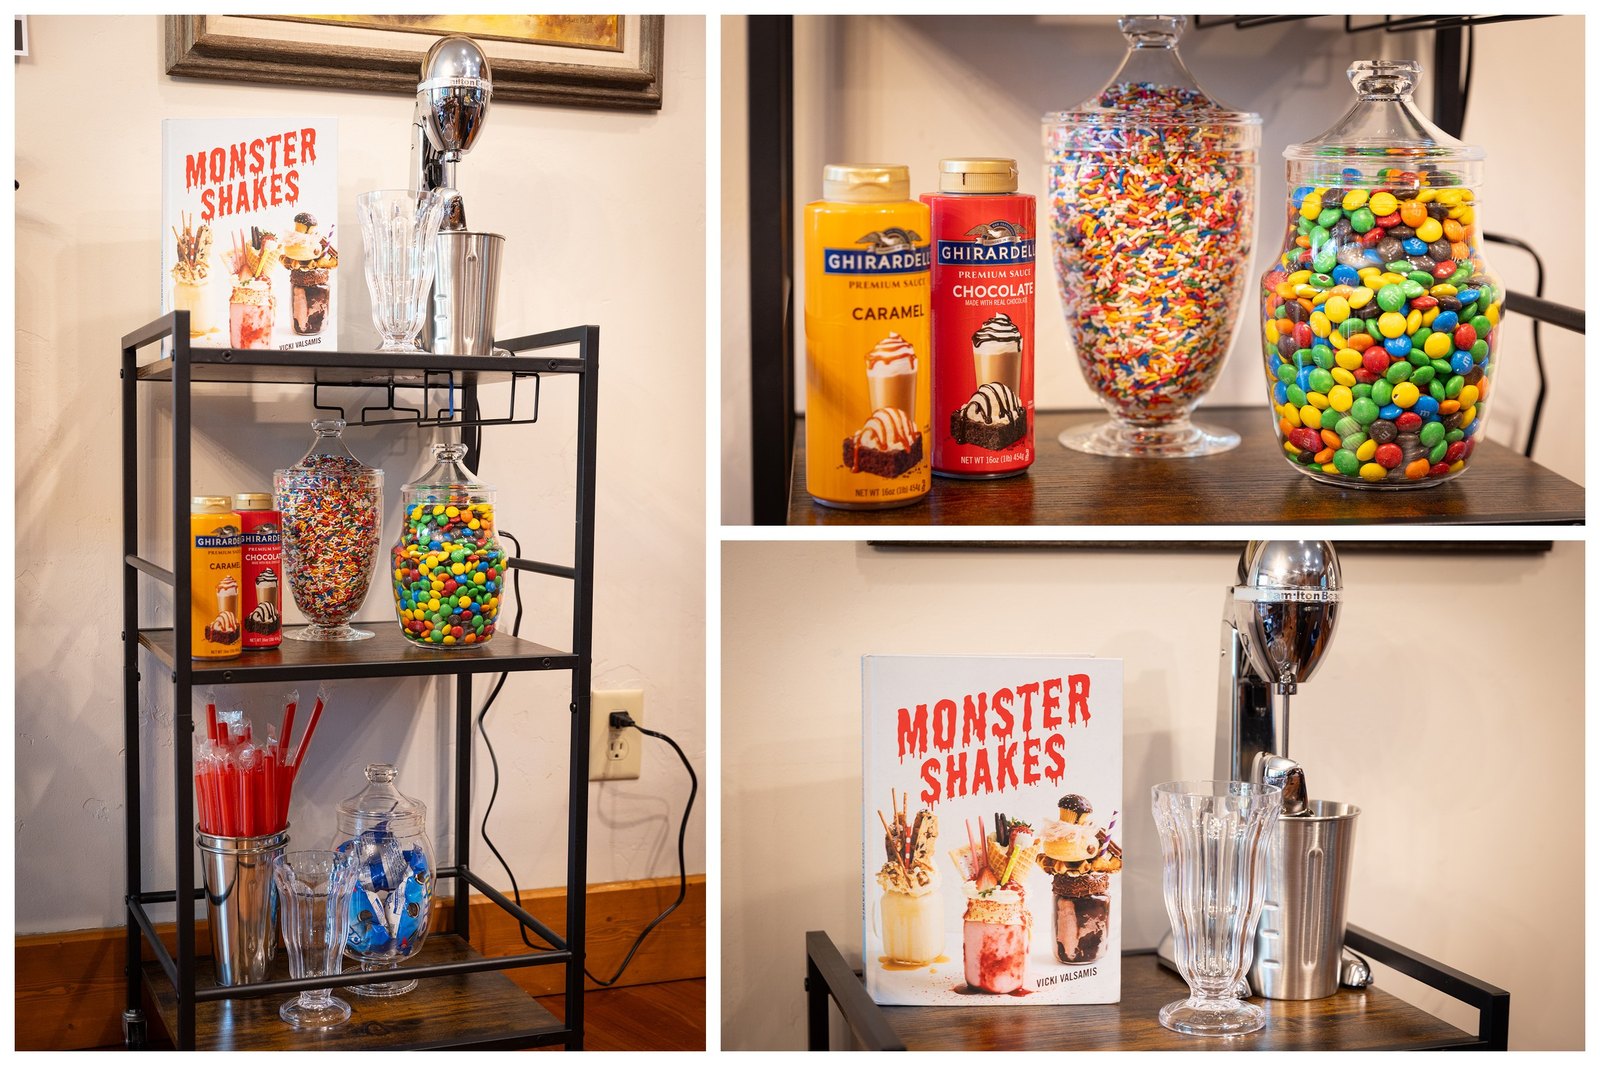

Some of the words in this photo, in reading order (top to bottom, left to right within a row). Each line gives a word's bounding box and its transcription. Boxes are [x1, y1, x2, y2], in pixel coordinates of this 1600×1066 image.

[185, 127, 317, 193] MONSTER
[201, 169, 300, 224] SHAKES
[958, 270, 1007, 279] PREMIUM
[1009, 268, 1031, 278] SAUCE
[848, 280, 901, 289] PREMIUM
[903, 277, 926, 287] SAUCE
[952, 281, 1034, 298] CHOCOLATE
[852, 303, 925, 321] CARAMEL
[279, 343, 294, 351] VICKI
[295, 336, 322, 349] VALSAMIS
[960, 456, 973, 464] NET
[974, 456, 984, 464] WT
[986, 456, 999, 464] 16oz
[855, 488, 868, 497] NET
[870, 488, 879, 497] WT
[897, 673, 1091, 764] MONSTER
[920, 733, 1066, 811] SHAKES
[1036, 976, 1058, 988] VICKI
[1060, 967, 1098, 983] VALSAMIS
